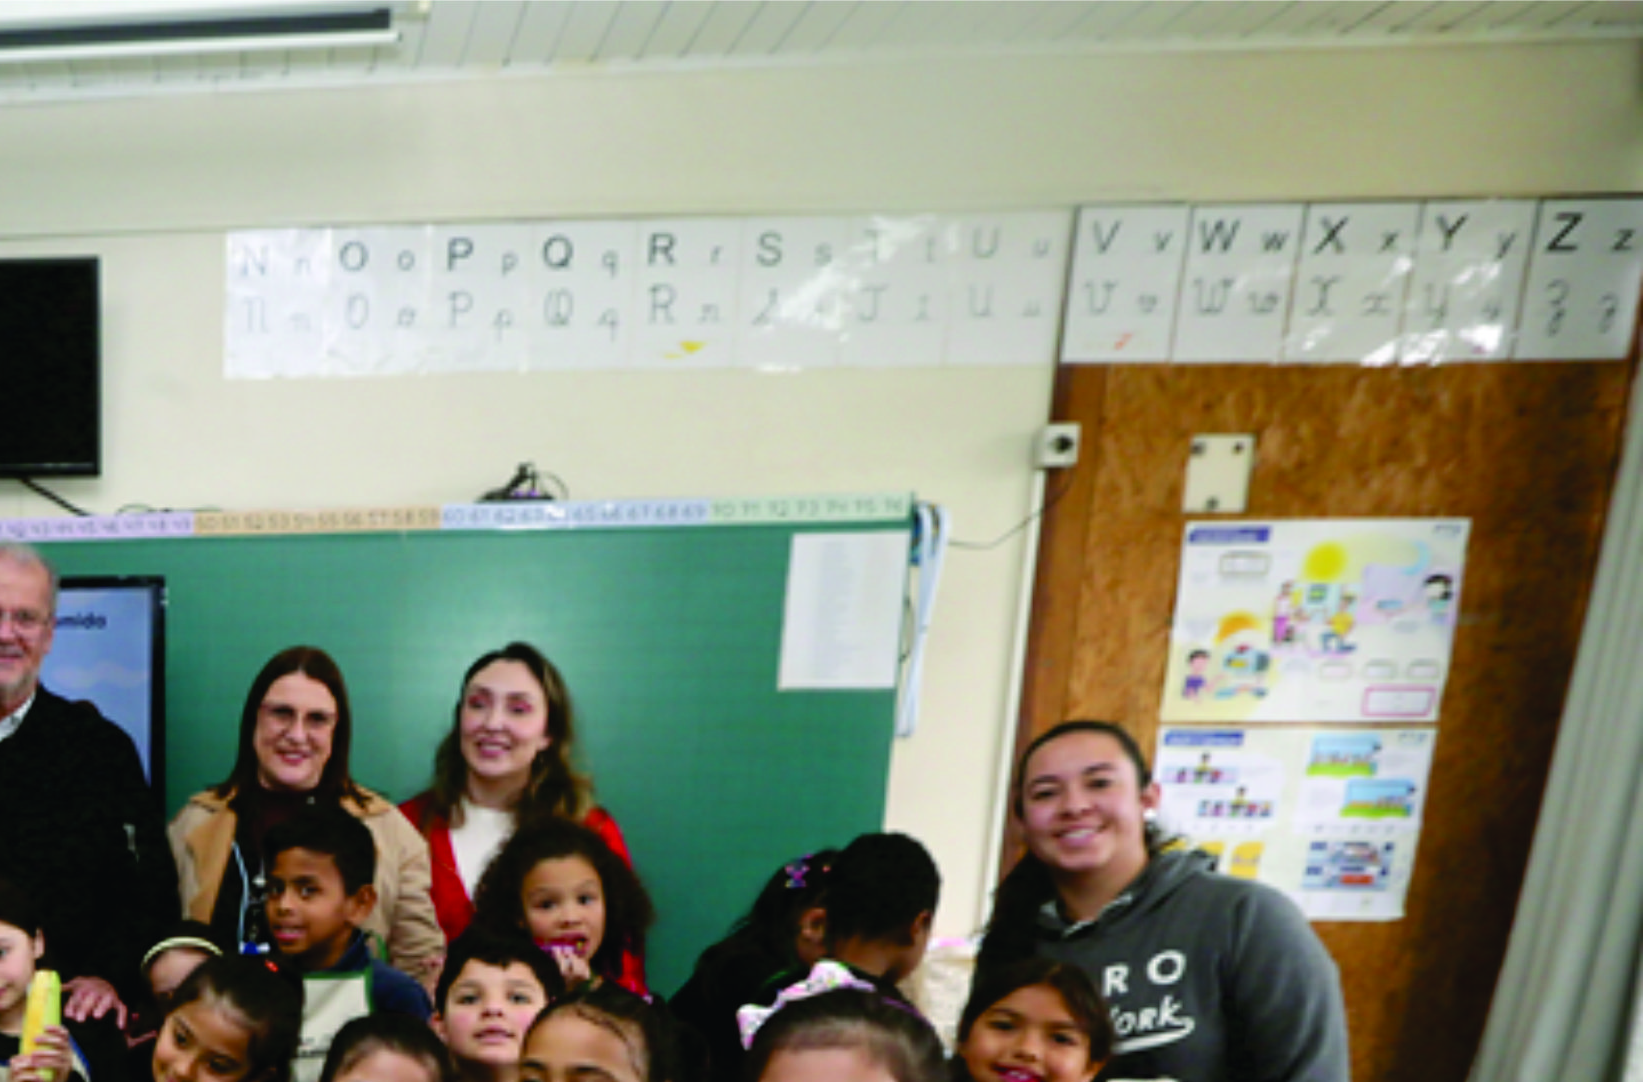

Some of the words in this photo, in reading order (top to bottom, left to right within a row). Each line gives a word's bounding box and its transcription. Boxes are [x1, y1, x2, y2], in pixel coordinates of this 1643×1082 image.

[340, 241, 367, 272] O
[398, 250, 414, 271] o
[447, 238, 473, 271] P
[502, 252, 517, 275] p
[543, 236, 573, 270] Q
[603, 251, 617, 276] q
[648, 234, 676, 265] R
[758, 233, 782, 266] S
[815, 244, 832, 264] s
[972, 227, 1000, 258] U
[1093, 221, 1121, 253] V
[1156, 233, 1172, 251] v
[1200, 221, 1239, 252] W
[1263, 232, 1289, 251] w
[1313, 217, 1348, 253] X
[1378, 231, 1399, 251] x
[1436, 215, 1468, 250] Y
[1495, 231, 1517, 258] y
[1547, 213, 1583, 251] Z
[1612, 230, 1634, 251] z
